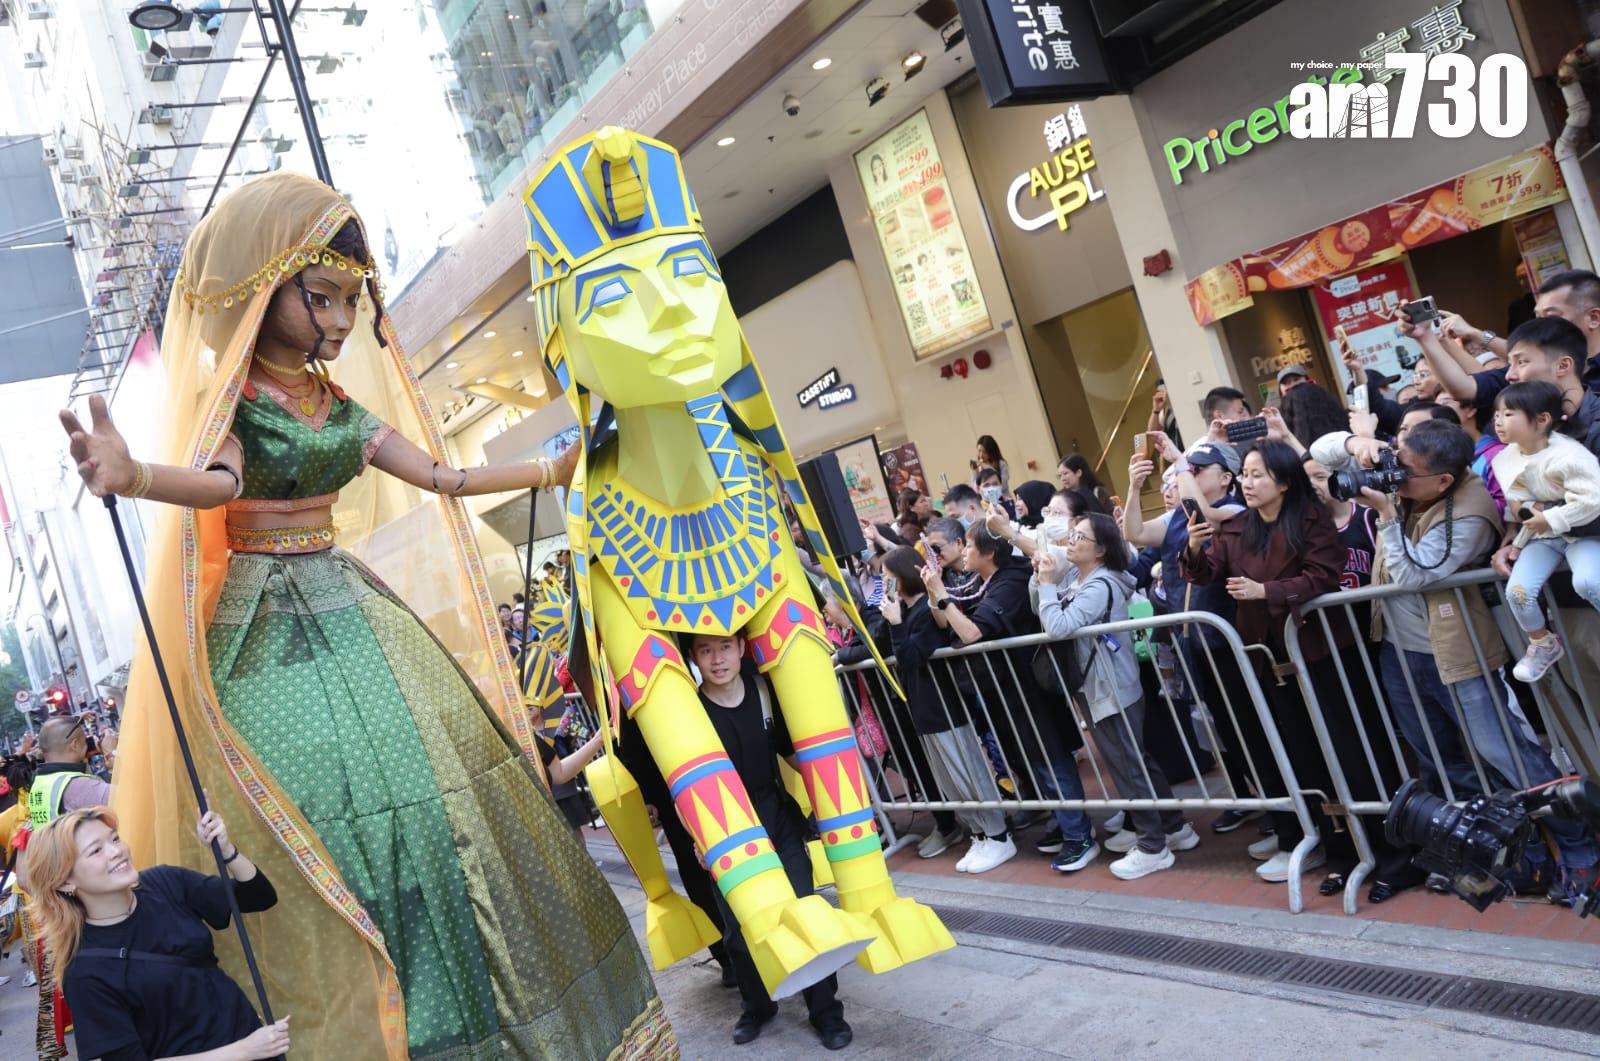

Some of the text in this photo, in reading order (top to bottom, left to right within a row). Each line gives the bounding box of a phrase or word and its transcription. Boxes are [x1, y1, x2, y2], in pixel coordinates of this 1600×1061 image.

[663, 42, 707, 95] Place
[1011, 0, 1048, 71] rite
[1037, 2, 1080, 70] 實惠
